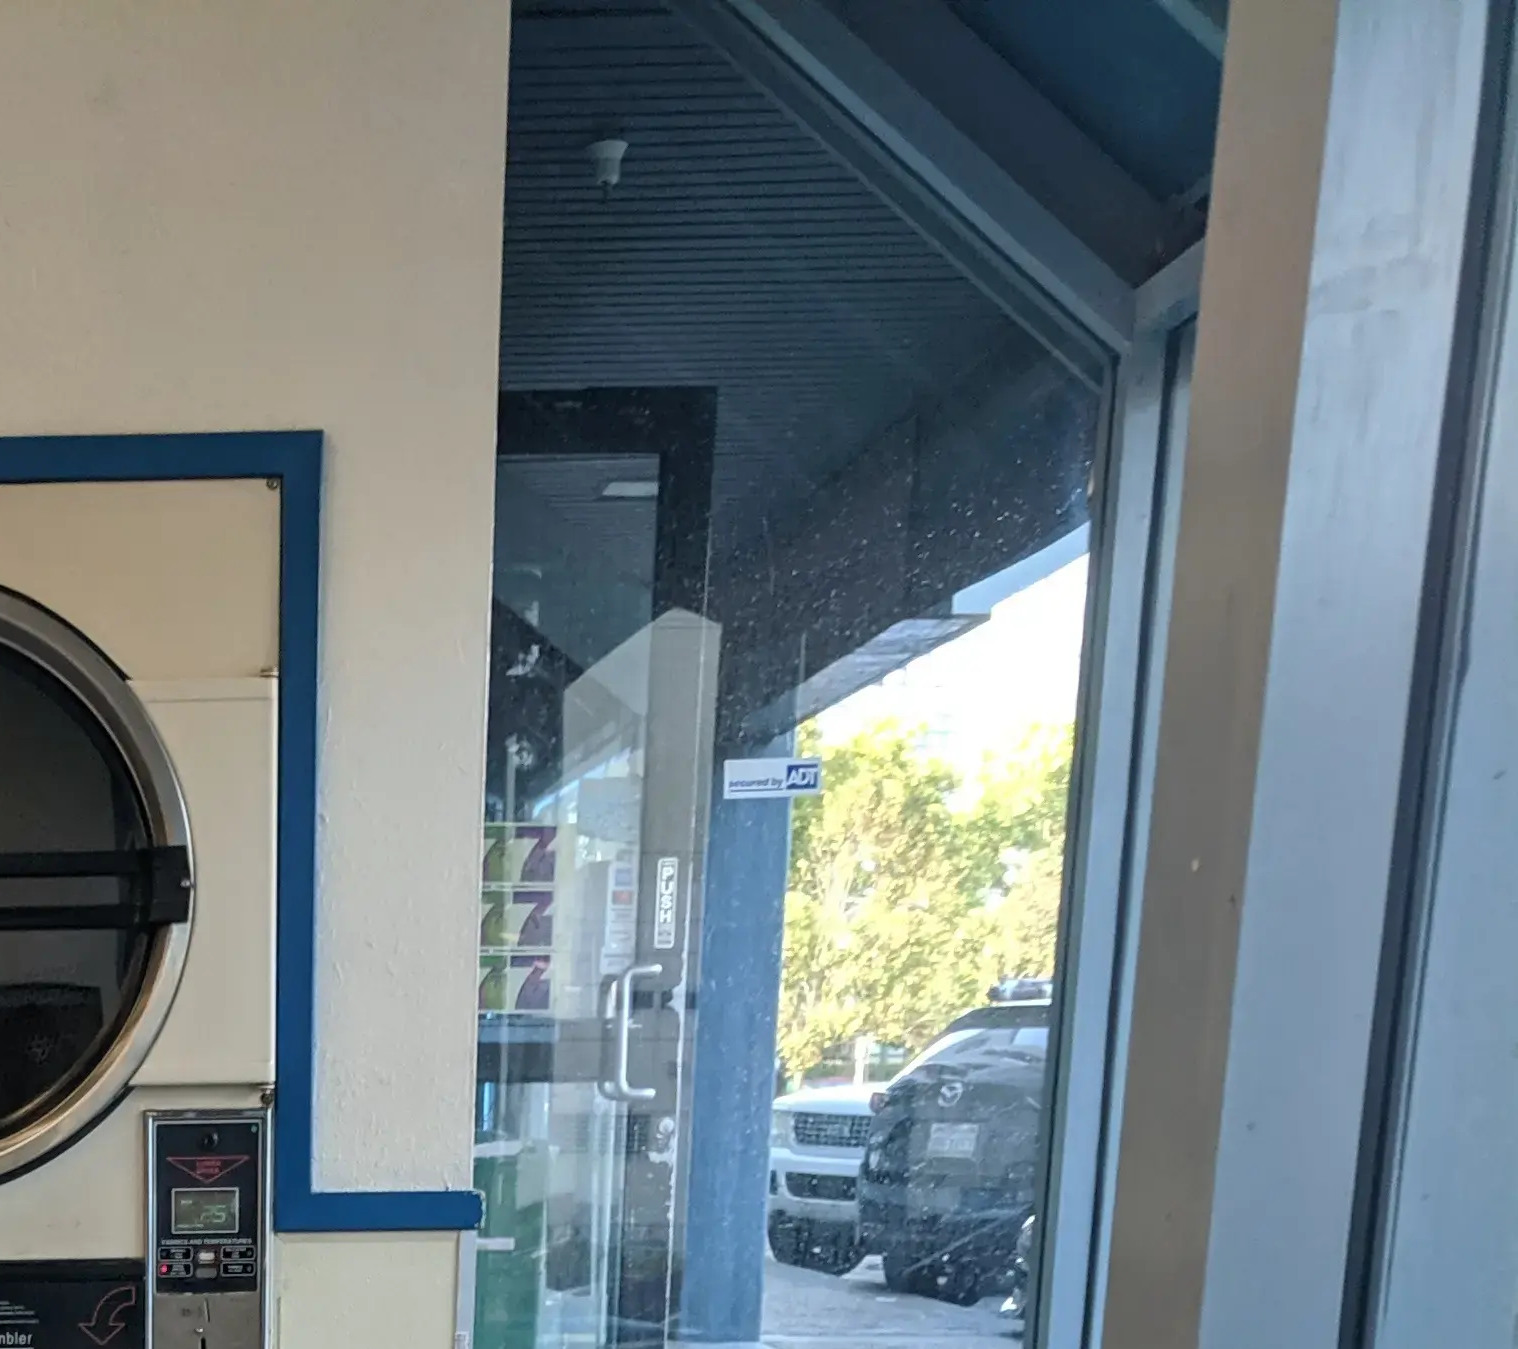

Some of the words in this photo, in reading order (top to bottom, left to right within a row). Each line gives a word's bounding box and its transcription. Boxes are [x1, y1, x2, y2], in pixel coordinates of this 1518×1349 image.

[729, 778, 770, 788] secured
[771, 778, 784, 789] by
[786, 767, 818, 787] ADT
[660, 866, 674, 923] PUSH
